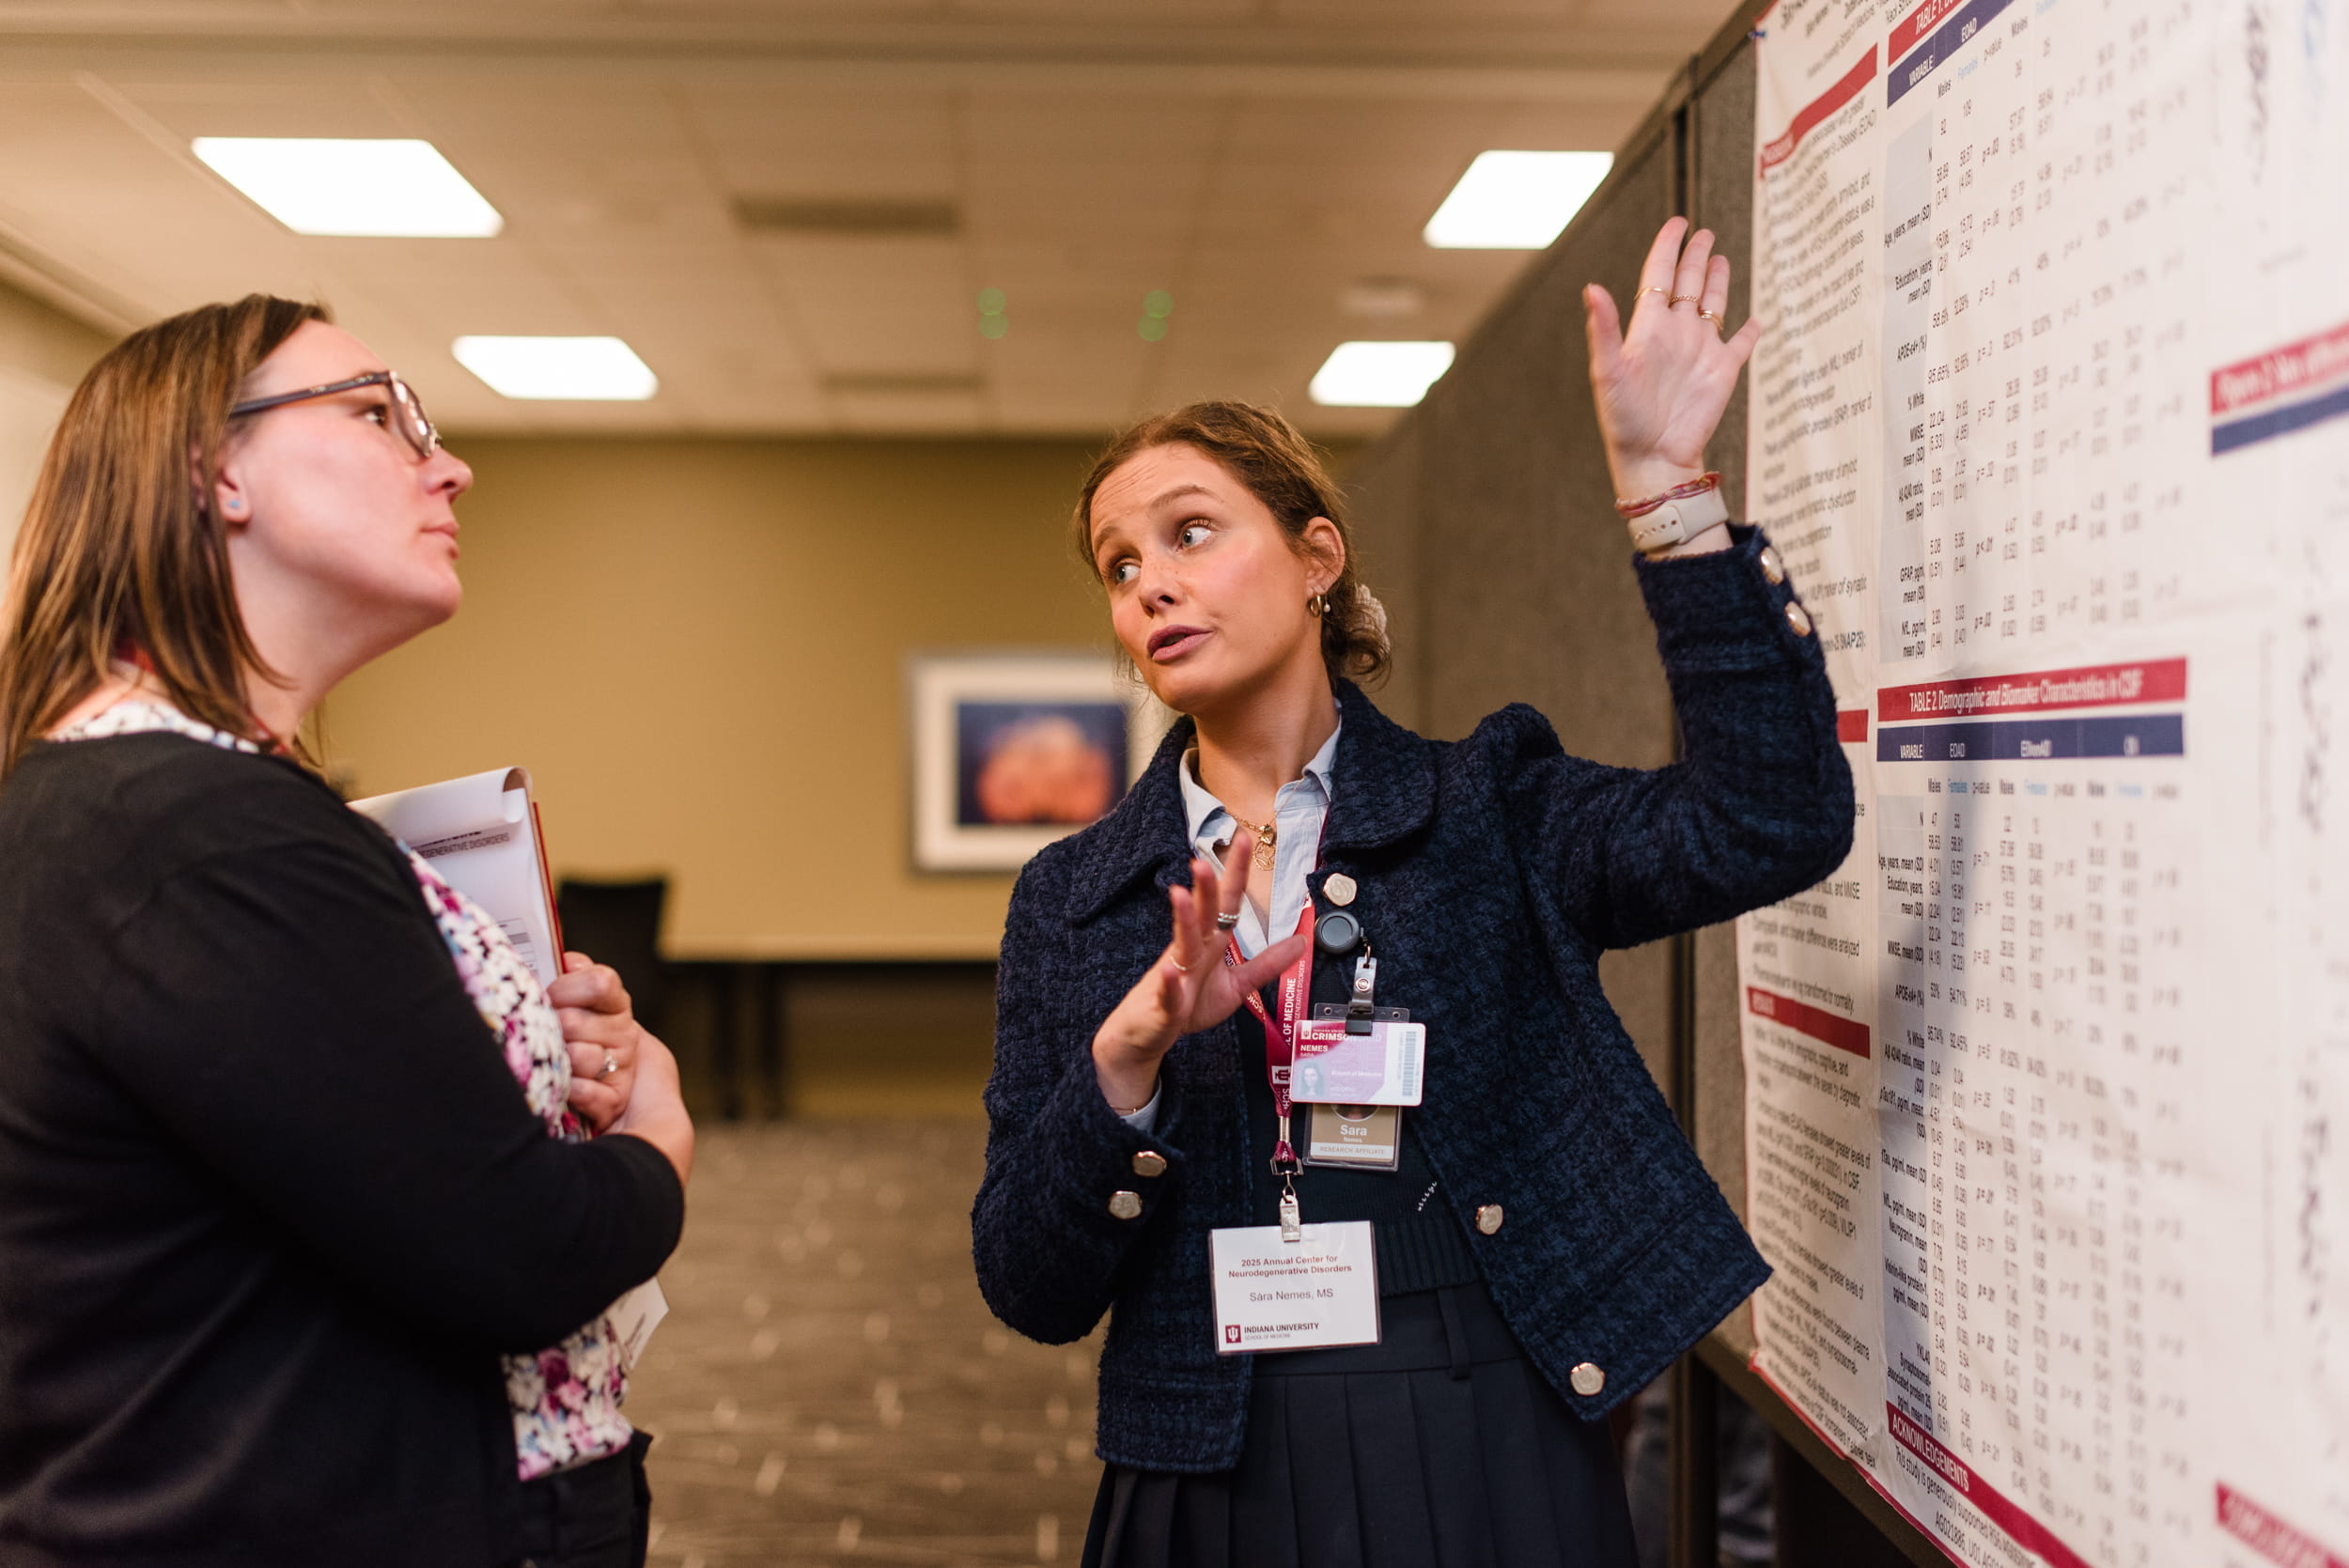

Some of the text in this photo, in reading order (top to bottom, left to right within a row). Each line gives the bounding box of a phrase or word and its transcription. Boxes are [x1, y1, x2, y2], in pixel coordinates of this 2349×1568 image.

[1909, 17, 1977, 86] VARIABLE EOAD
[1937, 80, 1952, 98] Males
[1921, 203, 1931, 225] (SD)
[1921, 278, 1931, 300] (SD)
[1927, 364, 1950, 384] 95.65%
[1913, 392, 1924, 408] White
[1929, 410, 1945, 428] 22.04
[1909, 690, 1931, 713] TABLE
[1938, 686, 1984, 714] Demographic
[1985, 686, 2000, 706] and
[2040, 673, 2108, 704] Characteristics
[1900, 744, 1923, 759] VARIABLE
[1951, 742, 1965, 759] EOAD
[1928, 779, 1941, 793] Males
[1948, 778, 1968, 793] Females
[1887, 857, 1900, 872] years,
[1901, 858, 1913, 870] mean
[1914, 857, 1923, 872] (SD)
[1888, 876, 1909, 894] Education,
[1901, 902, 1913, 915] mean
[1914, 902, 1923, 918] (SD)
[1902, 945, 1914, 960] mean
[1914, 946, 1924, 965] (SD)
[1298, 960, 1306, 988] DISORDERS
[1283, 978, 1296, 1035] OF MEDICINE
[1911, 1032, 1924, 1048] White
[1913, 1058, 1924, 1071] mean
[1914, 1078, 1923, 1097] (SD)
[1911, 1099, 1924, 1112] mean
[1340, 1125, 1368, 1136] Sara
[1917, 1122, 1926, 1141] (SD)
[1906, 1163, 1926, 1188] mean (SD)
[1906, 1207, 1926, 1233] mean (SD)
[1915, 1234, 1927, 1251] mean
[1229, 1265, 1352, 1278] Neurodegenerative Disorders
[1241, 1259, 1261, 1267] 2025
[1263, 1258, 1293, 1266] Annual
[1918, 1256, 1927, 1277] (SD)
[1250, 1288, 1334, 1302] Sara Nemes, MS
[1907, 1294, 1920, 1312] mean
[1920, 1298, 1929, 1323] (SD)
[1244, 1323, 1319, 1333] INDIANA UNIVERSITY
[1888, 1365, 1909, 1394] associated
[1909, 1379, 1924, 1402] protein
[1892, 1414, 1969, 1492] ACKNOWLEDGEMENTS
[1895, 1443, 1906, 1468] This
[1906, 1455, 1921, 1483] study
[1921, 1467, 1926, 1483] is
[1926, 1474, 1957, 1514] generously
